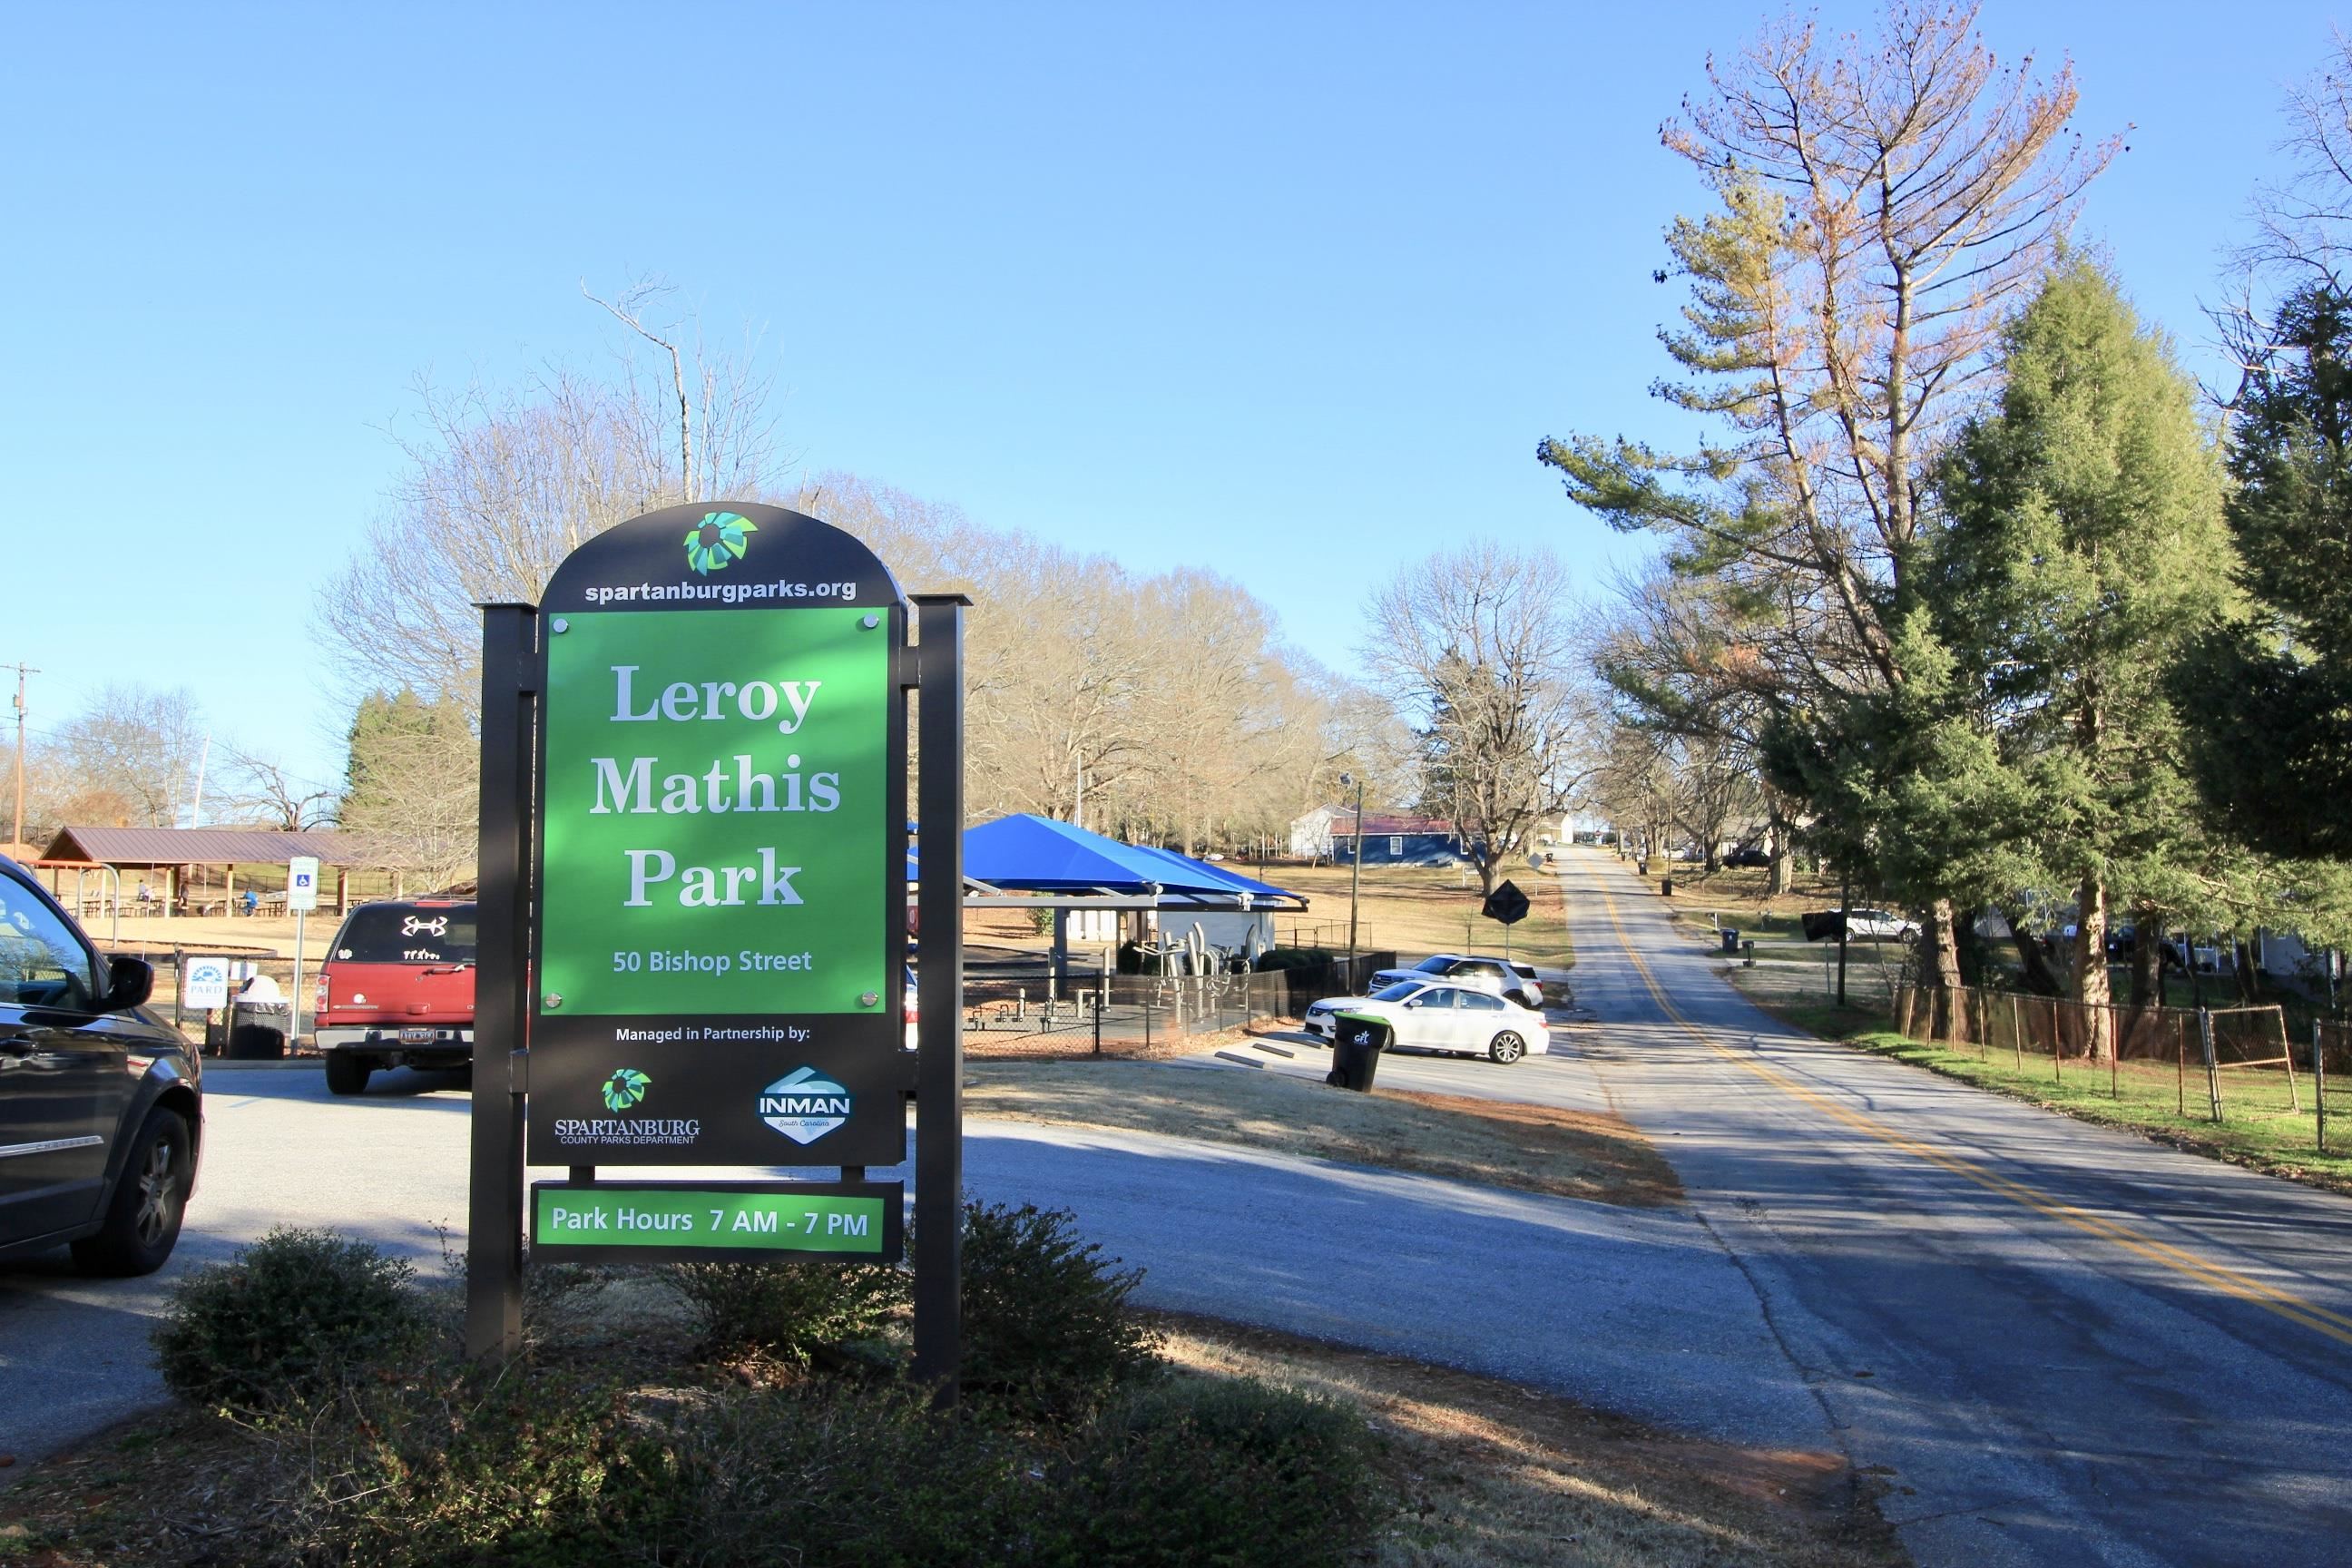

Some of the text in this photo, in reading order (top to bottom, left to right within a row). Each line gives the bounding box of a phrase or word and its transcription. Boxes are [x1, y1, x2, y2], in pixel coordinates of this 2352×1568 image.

[584, 579, 857, 605] spartanburgparks.org
[610, 664, 822, 735] Leroy
[589, 753, 840, 814] Mathis
[623, 847, 804, 907] Park
[613, 949, 812, 976] 50 Bishop Street
[191, 985, 223, 995] PARD
[616, 1025, 810, 1044] Managed in Partnership by:
[1354, 1031, 1368, 1044] GFL
[760, 1097, 850, 1114] INMAN
[554, 1119, 701, 1136] SPARTANBURG
[779, 1119, 829, 1128] South Carolina
[560, 1135, 695, 1144] COUNTY PARKS DEPARTMENT
[553, 1206, 608, 1230] Park
[617, 1208, 693, 1230] Hours
[710, 1210, 724, 1231] 7
[731, 1210, 778, 1233] AM
[804, 1211, 818, 1234] 7
[828, 1212, 867, 1236] PM
